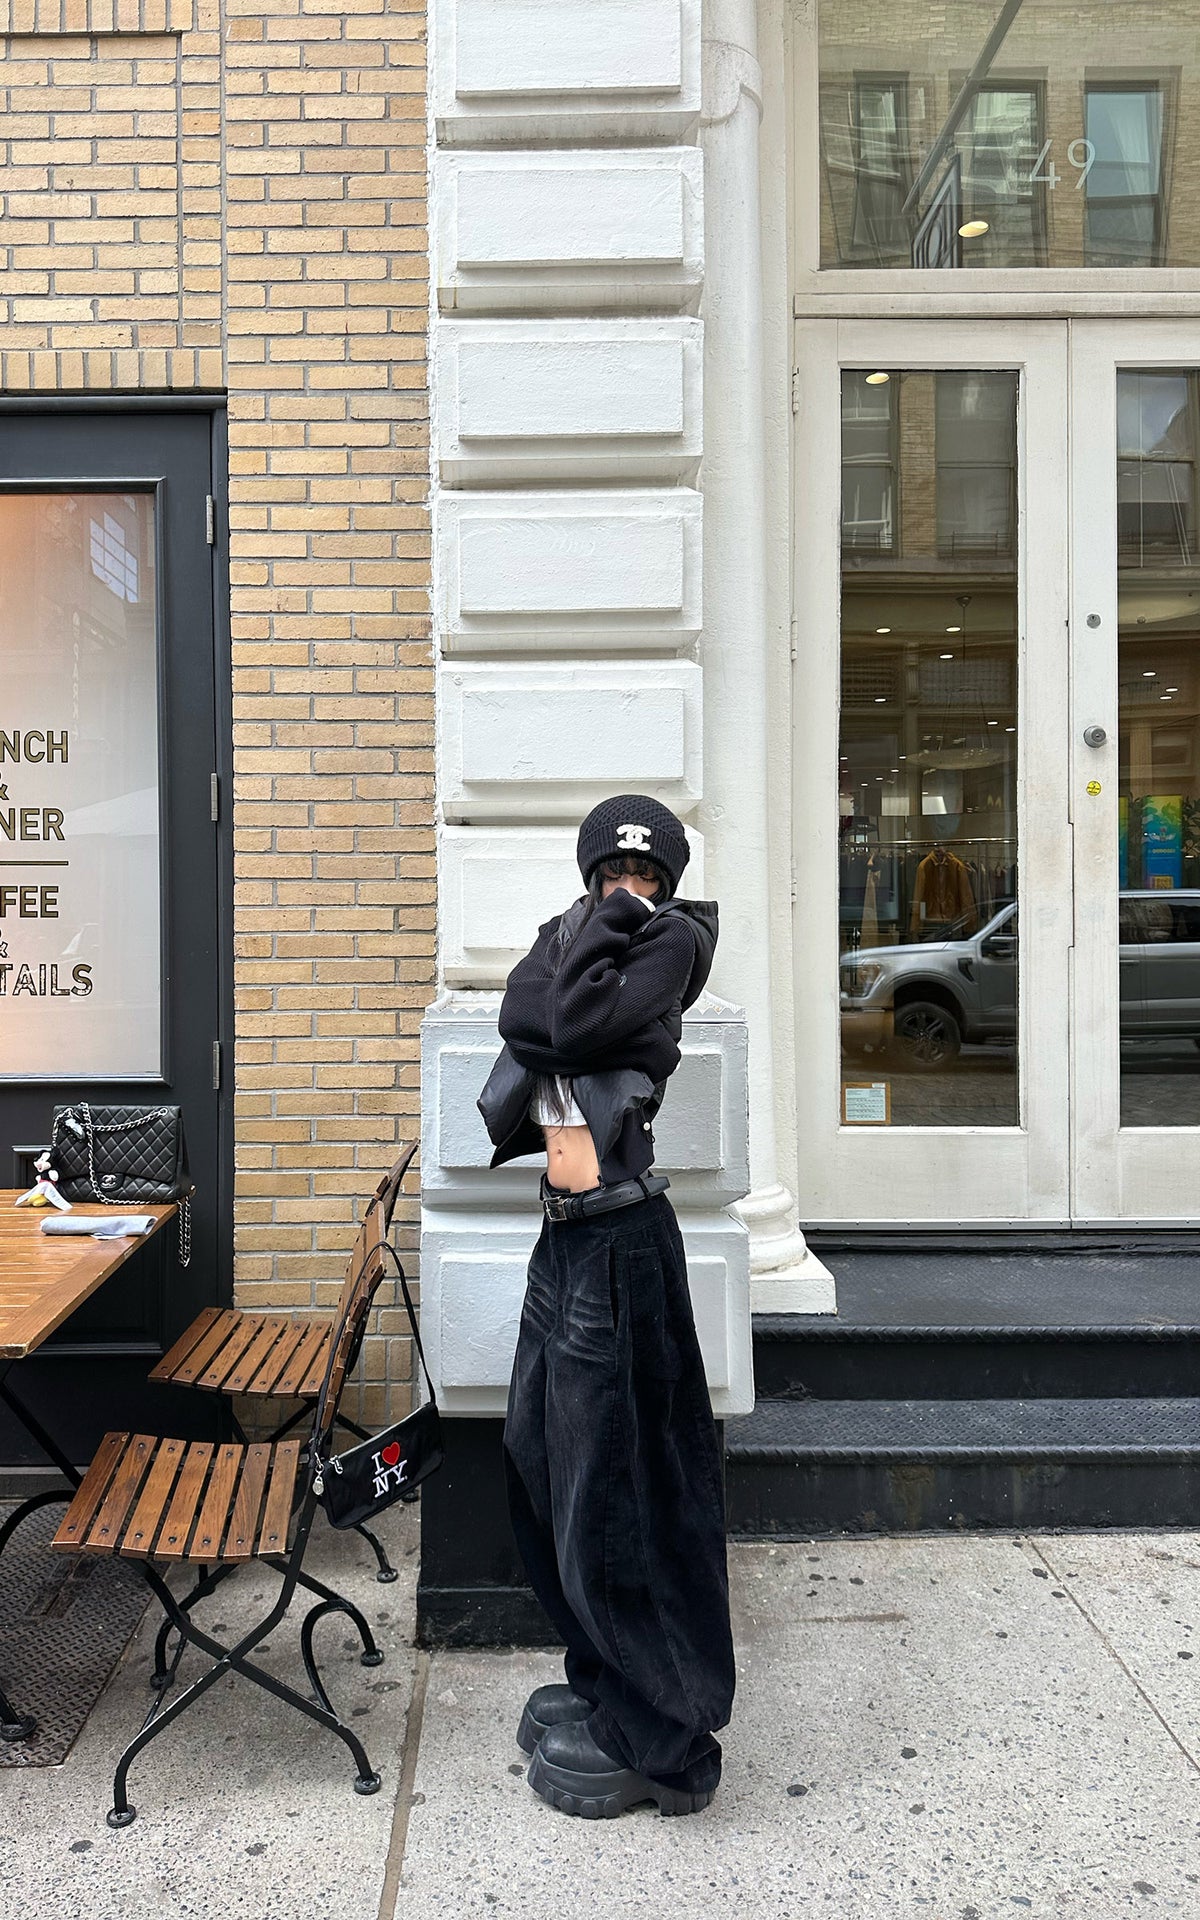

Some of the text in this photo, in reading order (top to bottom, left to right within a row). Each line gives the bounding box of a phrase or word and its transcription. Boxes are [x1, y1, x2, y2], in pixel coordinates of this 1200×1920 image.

[1029, 138, 1096, 190] 49
[0, 730, 69, 763] NCH
[0, 807, 66, 841] NER
[0, 885, 59, 918] FEE
[0, 963, 93, 997] TAILS
[371, 1451, 385, 1475] I
[372, 1459, 408, 1498] NY
